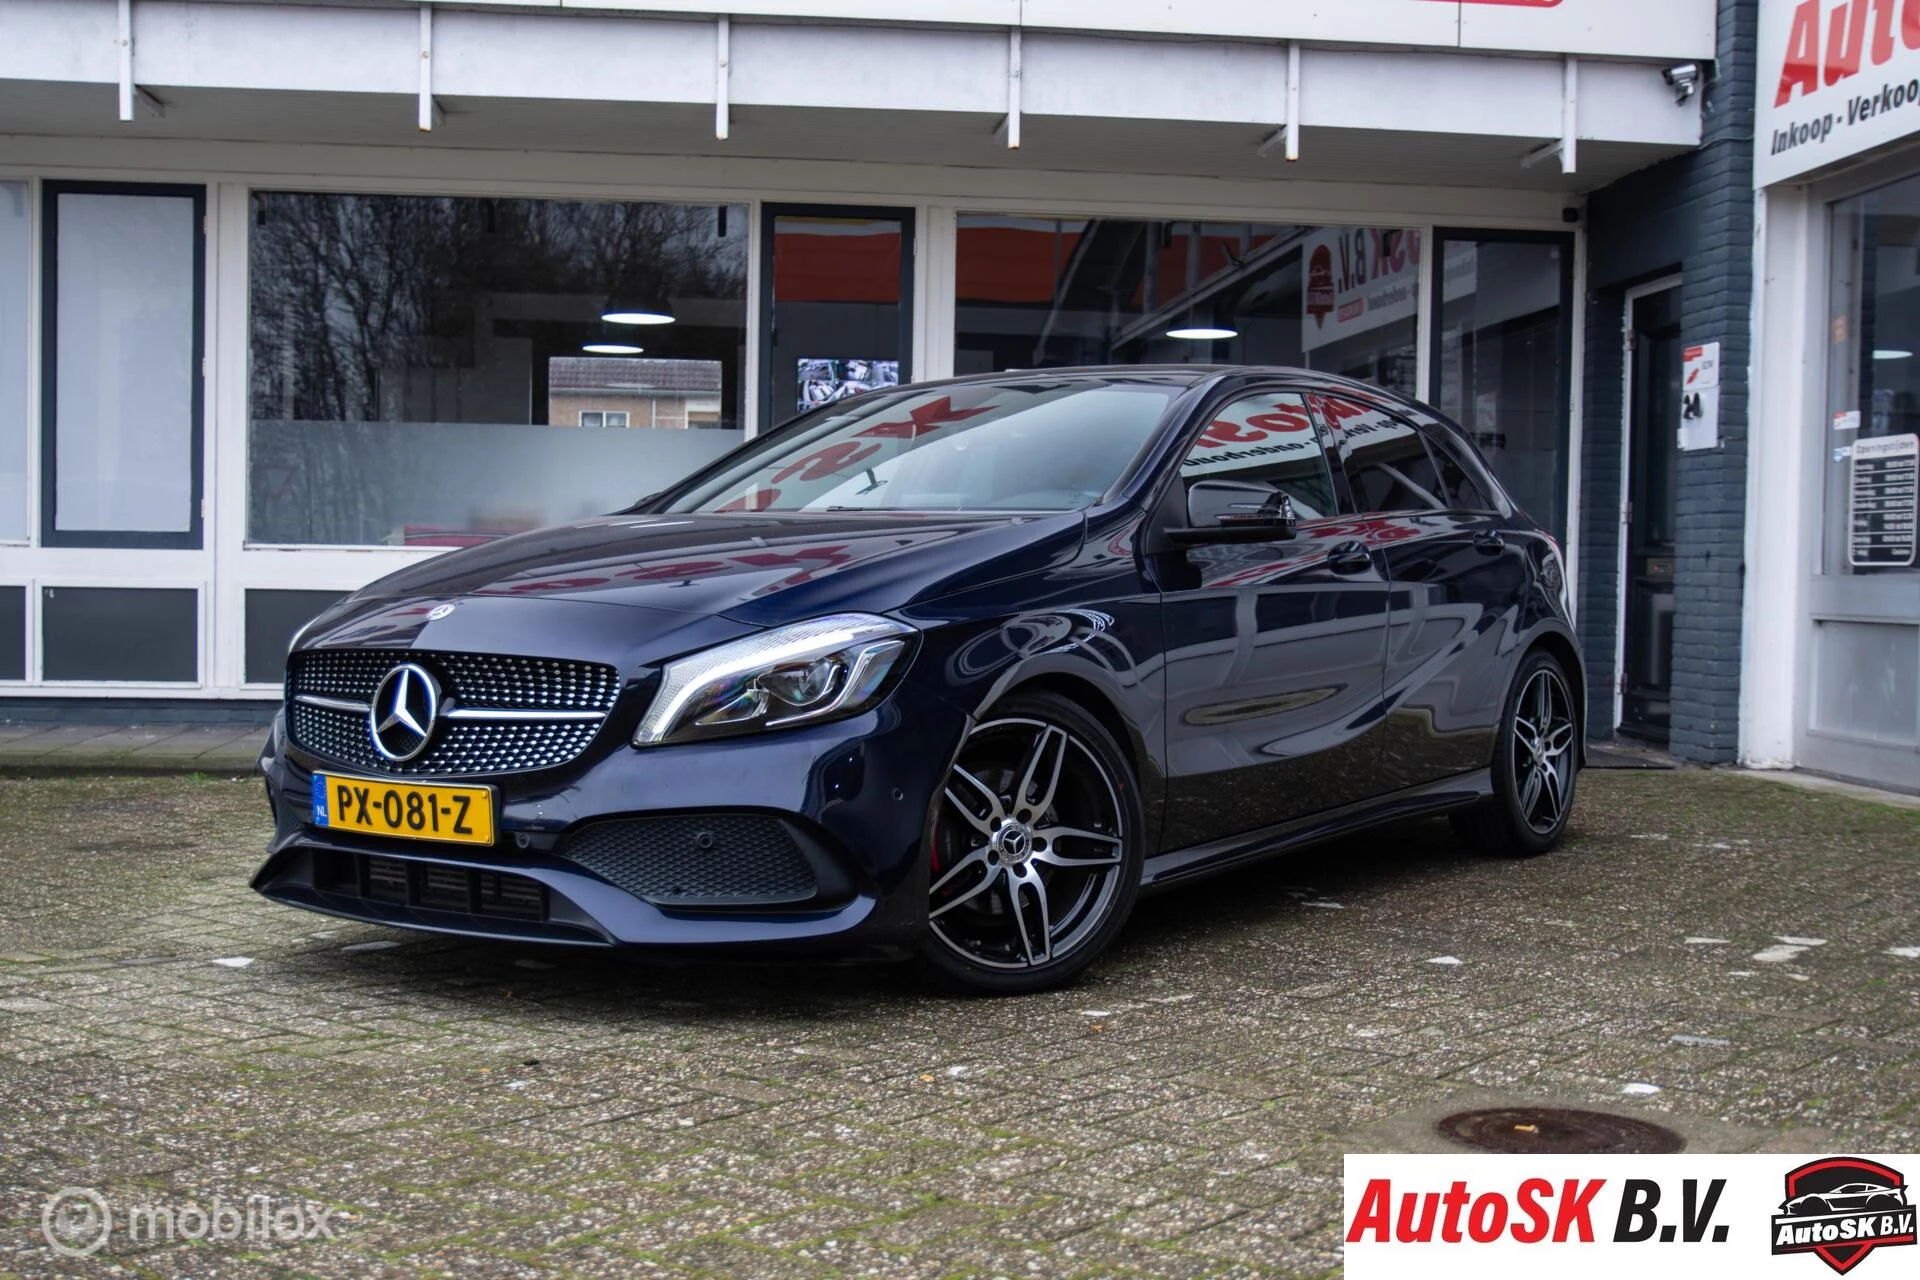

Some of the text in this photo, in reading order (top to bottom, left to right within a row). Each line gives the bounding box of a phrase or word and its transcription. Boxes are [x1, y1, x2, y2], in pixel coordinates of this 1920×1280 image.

[1771, 113, 1833, 155] Inkoop
[1848, 79, 1920, 126] Verkoo
[317, 785, 473, 835] NL PX-081-Z
